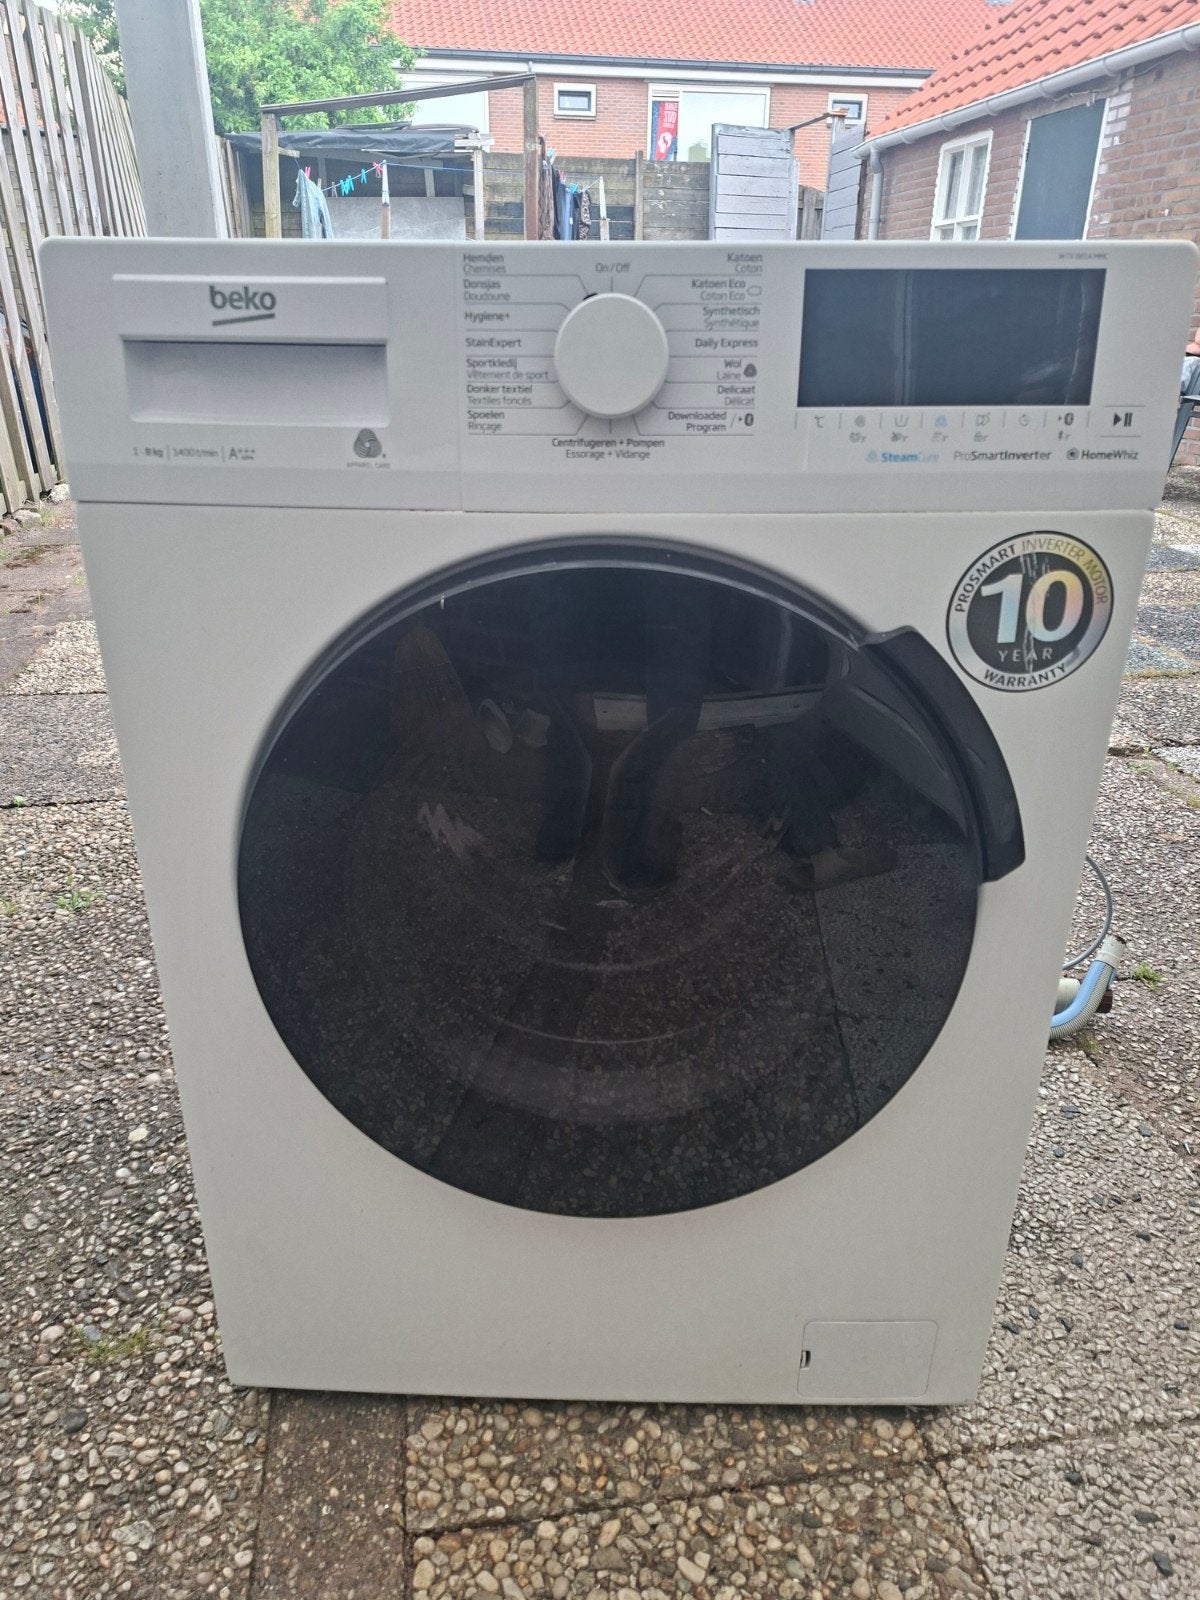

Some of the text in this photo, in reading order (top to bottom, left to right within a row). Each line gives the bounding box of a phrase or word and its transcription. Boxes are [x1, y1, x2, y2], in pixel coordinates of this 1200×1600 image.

[463, 253, 504, 263] Hemden
[727, 253, 762, 263] Katoen
[463, 264, 507, 274] Chemises
[735, 264, 763, 273] Coton
[463, 279, 502, 291] Donsjas
[691, 279, 746, 289] Katoen Eco
[209, 285, 277, 311] beko
[464, 291, 511, 301] Doudoune
[701, 291, 745, 301] Coton Eco
[702, 306, 760, 320] Synthetisch
[465, 338, 522, 349] StainExpert
[695, 338, 759, 350] Daily Express
[466, 358, 518, 370] Sportkledij
[724, 360, 742, 369] Wol
[512, 371, 523, 380] de
[525, 372, 549, 381] sport
[716, 371, 742, 381] Laine
[466, 384, 533, 394] Donker textiel
[717, 385, 756, 395] Delicaat
[467, 396, 502, 406] Textiles
[467, 410, 505, 421] Spoelen
[668, 411, 727, 421] Downloaded
[468, 421, 503, 434] Rinçage
[686, 422, 727, 434] Program
[551, 438, 617, 450] Centrifugeren
[626, 439, 665, 449] Pompen
[565, 449, 605, 460] Essorage
[615, 450, 651, 461] Vidange
[953, 450, 1051, 461] ProSmartInverter
[1080, 450, 1139, 461] HomeWhiz
[955, 537, 1109, 613] PROSMART INVERTER MOTOR
[980, 569, 1085, 644] 10
[998, 647, 1053, 663] YEAR
[983, 663, 1067, 687] WARRANTY
